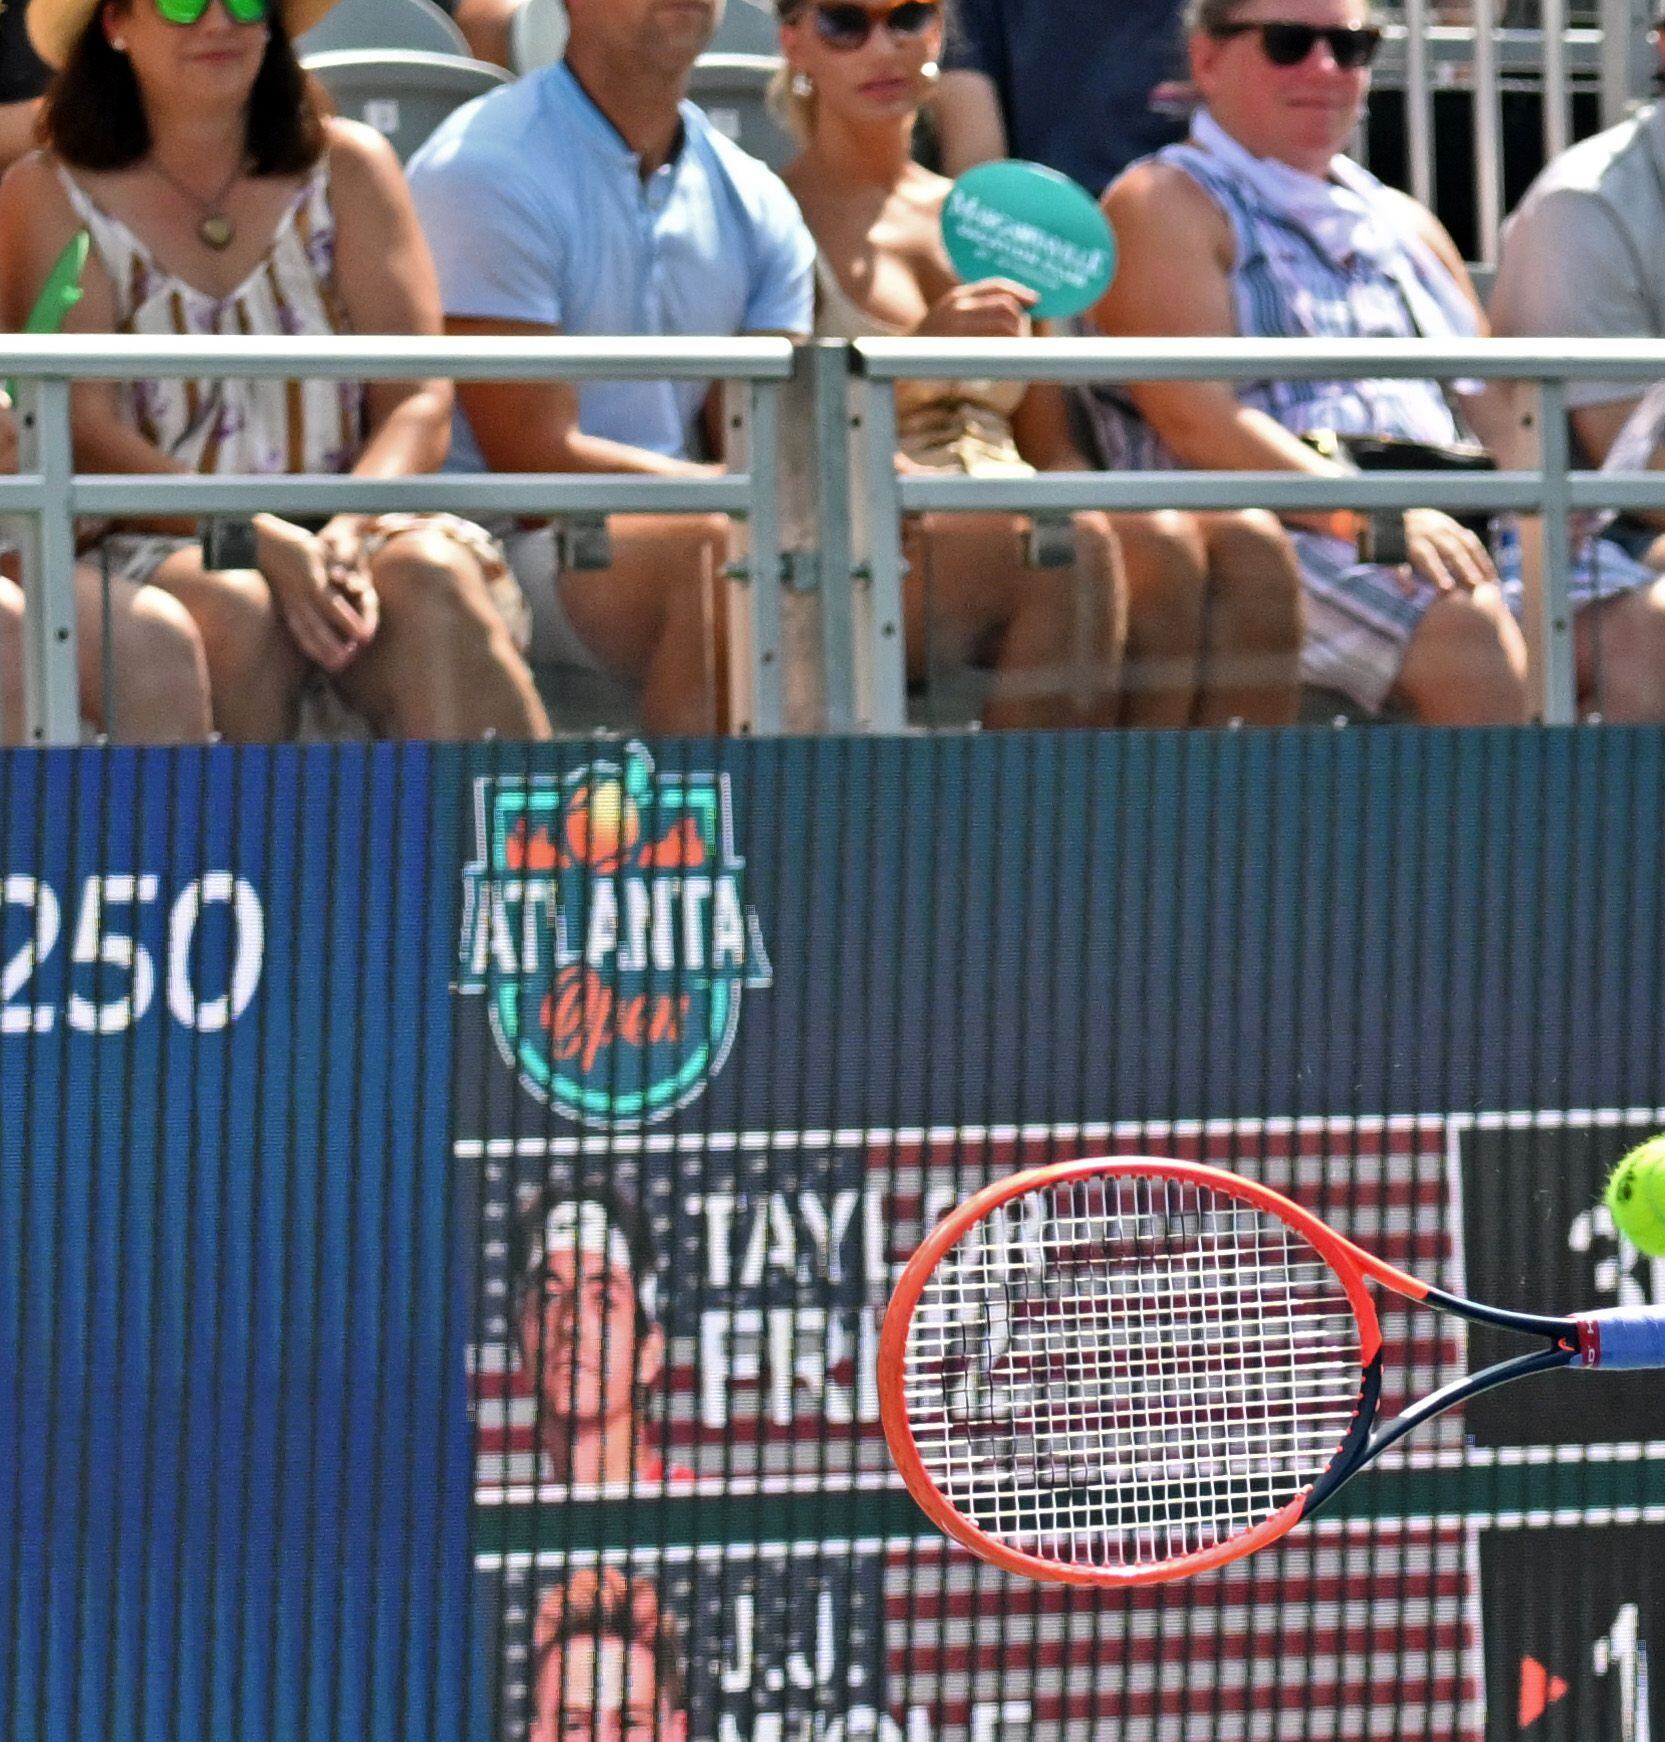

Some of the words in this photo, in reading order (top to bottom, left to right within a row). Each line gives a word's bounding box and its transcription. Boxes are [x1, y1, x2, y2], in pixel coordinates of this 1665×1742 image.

[0, 870, 264, 1034] 250
[470, 876, 746, 975] ATLANTA
[540, 966, 692, 1073] Open
[719, 1593, 869, 1692] J.J.
